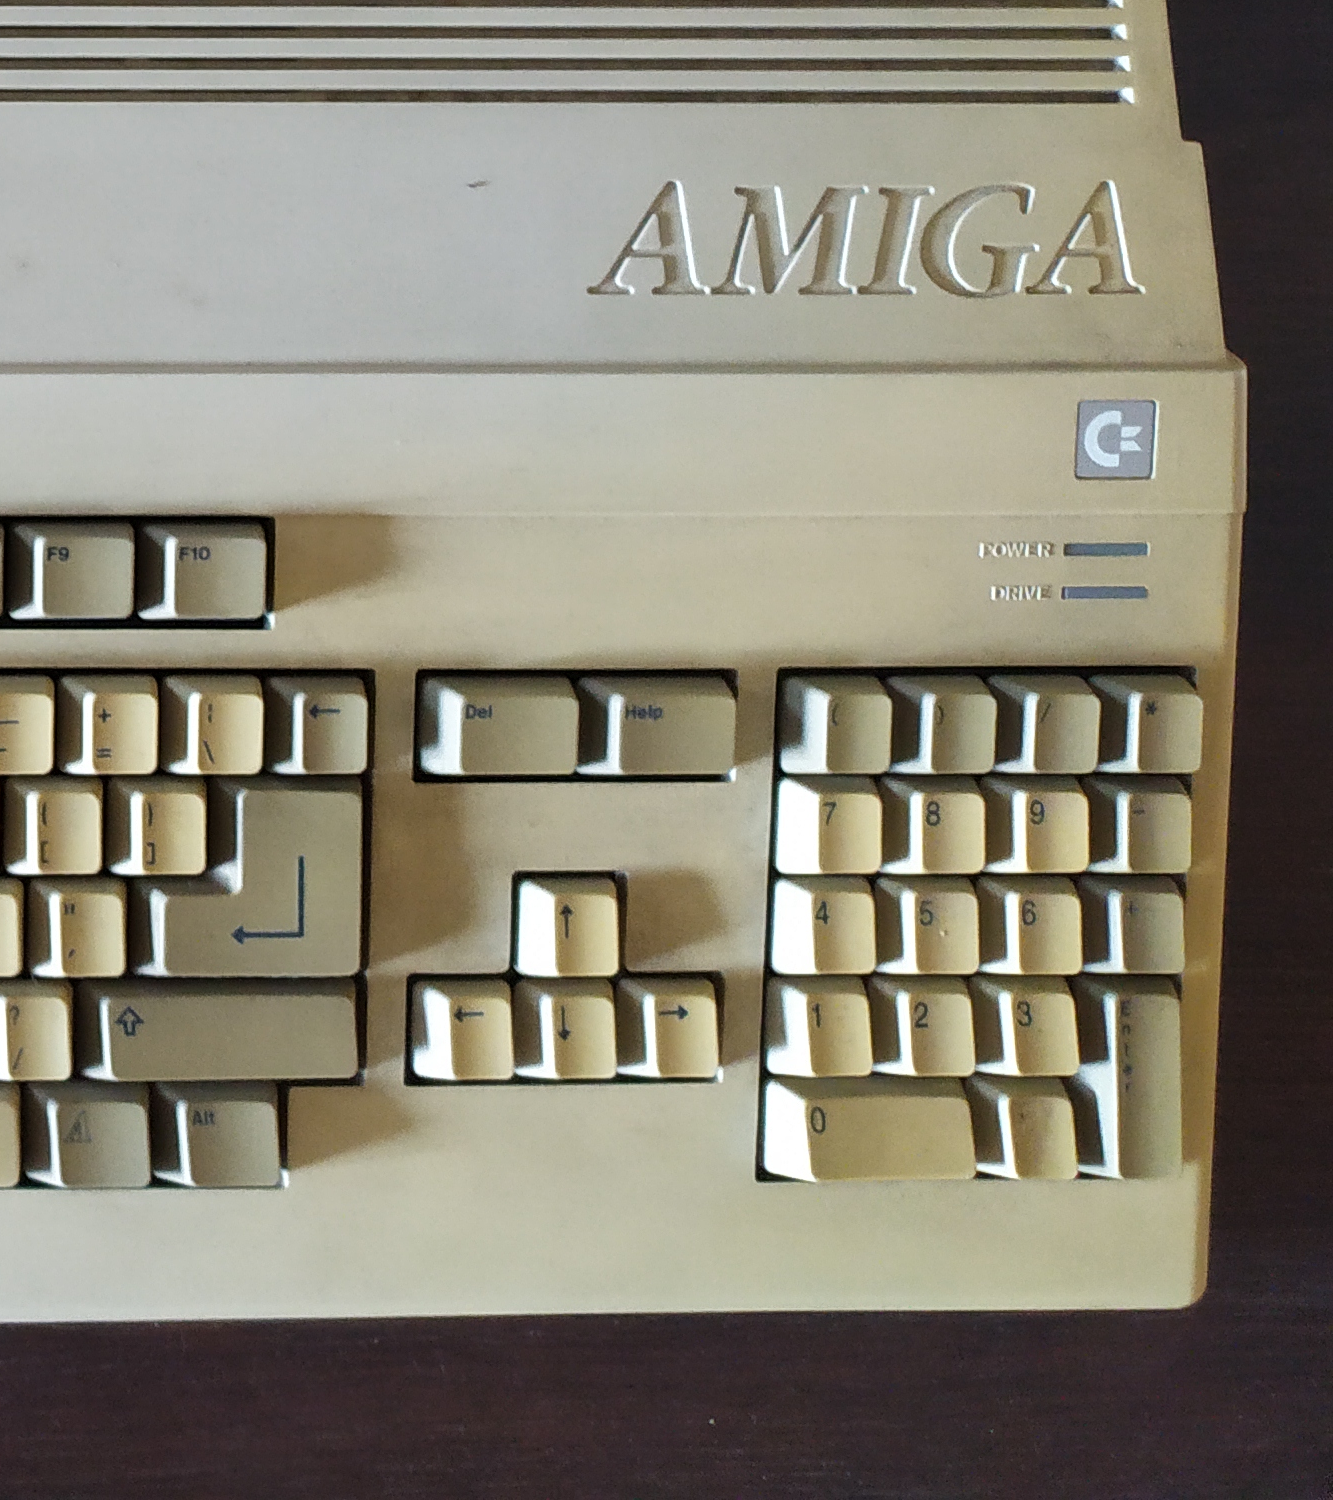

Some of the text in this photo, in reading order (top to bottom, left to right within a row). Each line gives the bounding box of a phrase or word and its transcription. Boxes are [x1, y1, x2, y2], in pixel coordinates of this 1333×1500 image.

[586, 180, 1146, 298] AMIGA
[47, 546, 69, 561] F9
[179, 546, 211, 561] F10
[978, 542, 1054, 558] POWER
[990, 585, 1051, 601] DRIVE
[95, 708, 111, 723] +
[465, 704, 492, 719] Del
[625, 705, 663, 721] Help
[96, 748, 111, 757] =
[822, 802, 837, 826] 7
[925, 800, 941, 827] 8
[1030, 799, 1045, 825] 9
[40, 840, 49, 867] [
[147, 843, 154, 864] ]
[815, 901, 829, 924] 4
[919, 900, 934, 926] 5
[1021, 899, 1036, 926] 6
[10, 1005, 20, 1025] ?
[812, 1003, 821, 1028] 1
[914, 1002, 928, 1029] 2
[1017, 1001, 1032, 1027] 3
[192, 1110, 215, 1126] Alt
